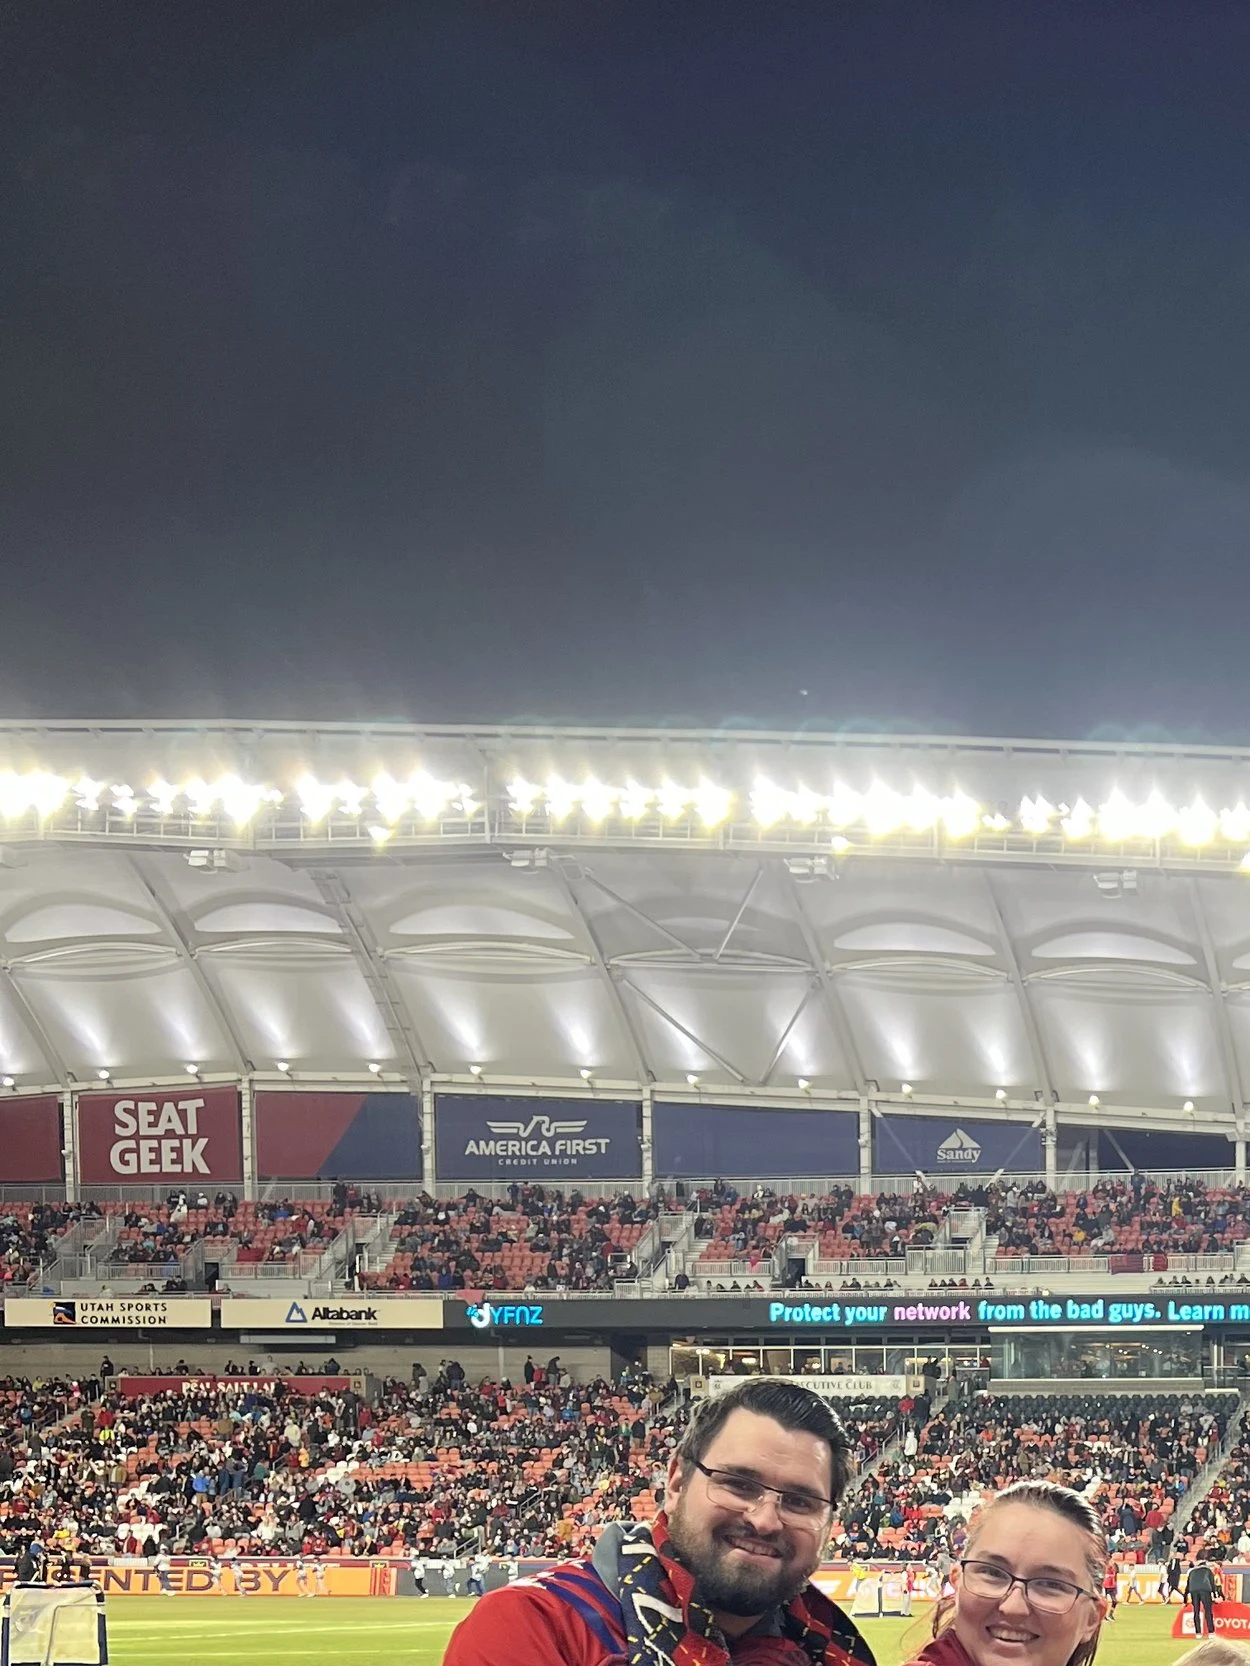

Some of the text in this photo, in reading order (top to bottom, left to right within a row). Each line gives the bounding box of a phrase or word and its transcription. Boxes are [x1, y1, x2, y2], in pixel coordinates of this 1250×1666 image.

[114, 1098, 205, 1137] SEAT
[464, 1138, 611, 1156] AMERICA FIRST
[936, 1147, 982, 1163] Sandy
[109, 1137, 211, 1175] GEEK
[498, 1157, 578, 1166] CREDIT UNION
[80, 1302, 168, 1312] UTAH SPORTS
[311, 1306, 378, 1321] Altabank
[769, 1301, 841, 1323] Protect
[844, 1303, 888, 1326] your
[893, 1301, 971, 1321] network
[977, 1299, 1024, 1321] from
[1029, 1299, 1062, 1320] the
[1065, 1298, 1104, 1320] bad
[1107, 1301, 1162, 1323] guys.
[1167, 1300, 1225, 1321] Learn
[80, 1315, 168, 1325] COMMISSION
[800, 1380, 873, 1391] CUTIVE CLUB
[234, 1569, 291, 1592] BY
